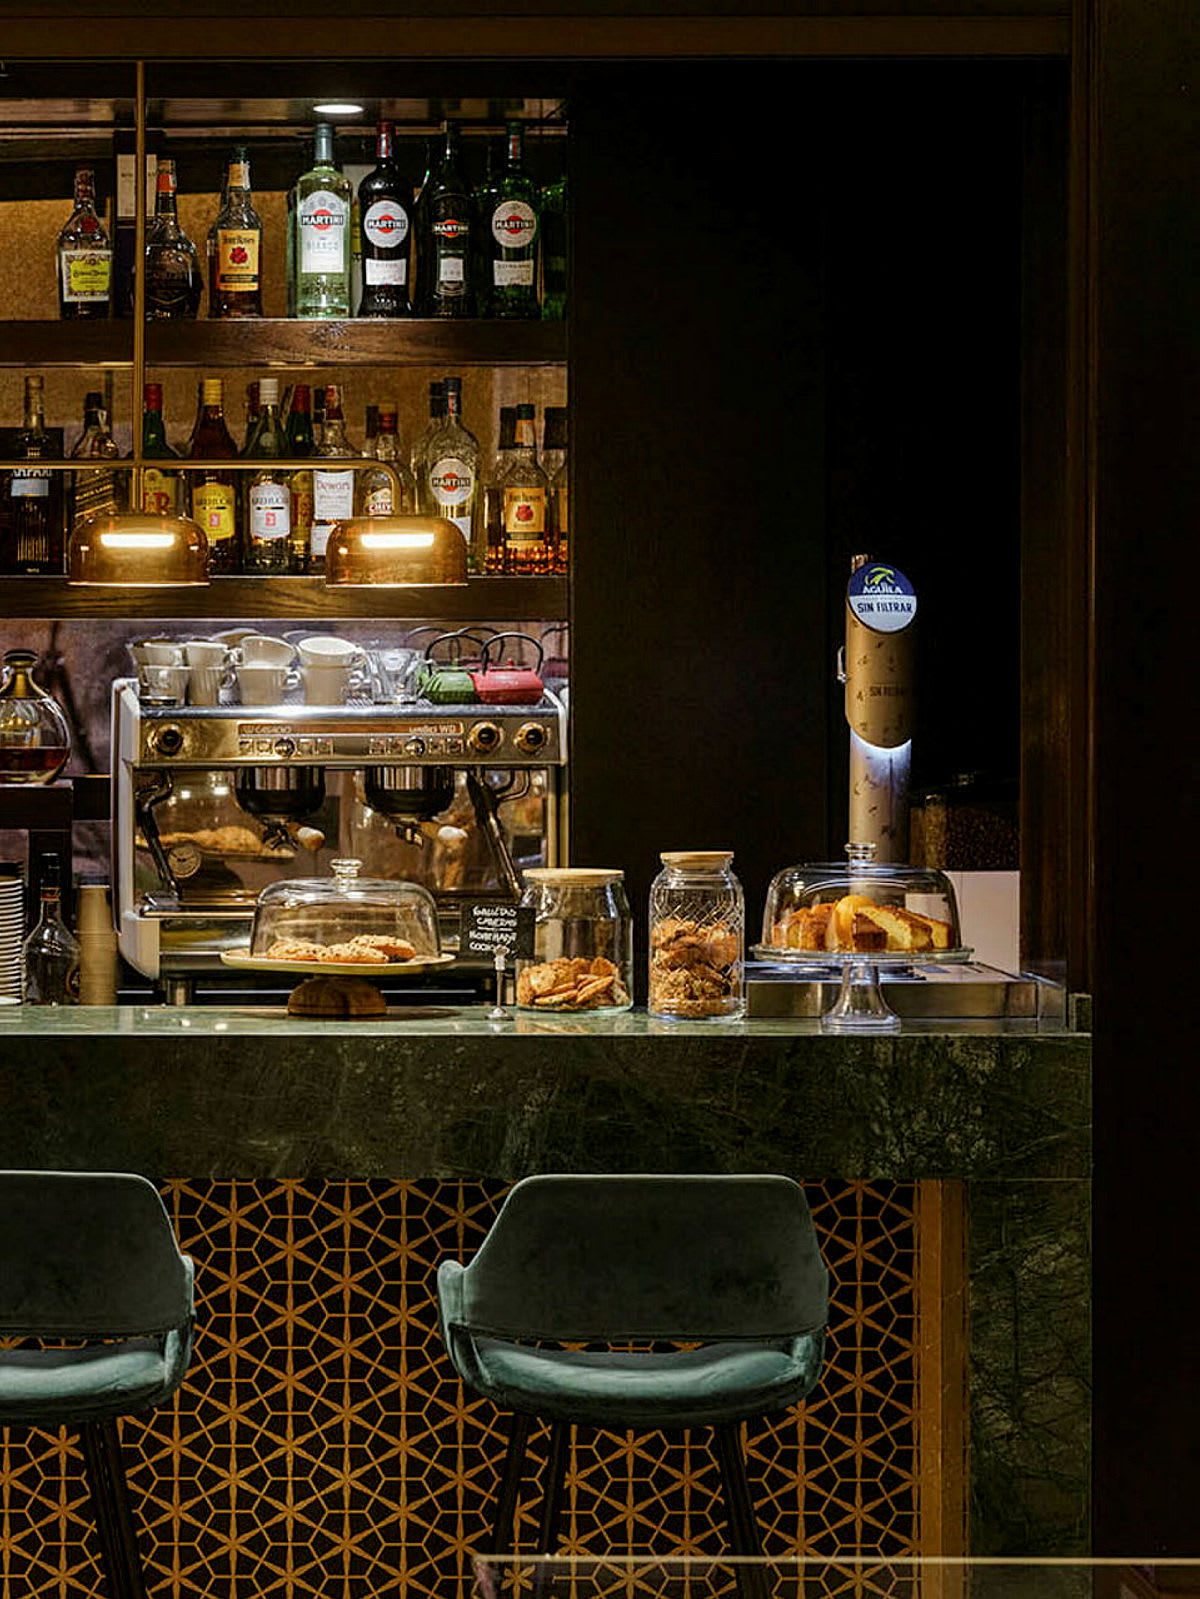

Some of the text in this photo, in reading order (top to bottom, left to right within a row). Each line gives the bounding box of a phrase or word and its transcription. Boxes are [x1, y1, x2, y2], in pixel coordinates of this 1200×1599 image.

[301, 215, 343, 225] MARTINI
[368, 220, 406, 229] MARTINI
[495, 220, 534, 229] MARTINI
[432, 224, 469, 232] MARTINI
[432, 478, 471, 487] MARTINI
[858, 601, 913, 613] SIN FILTRAR
